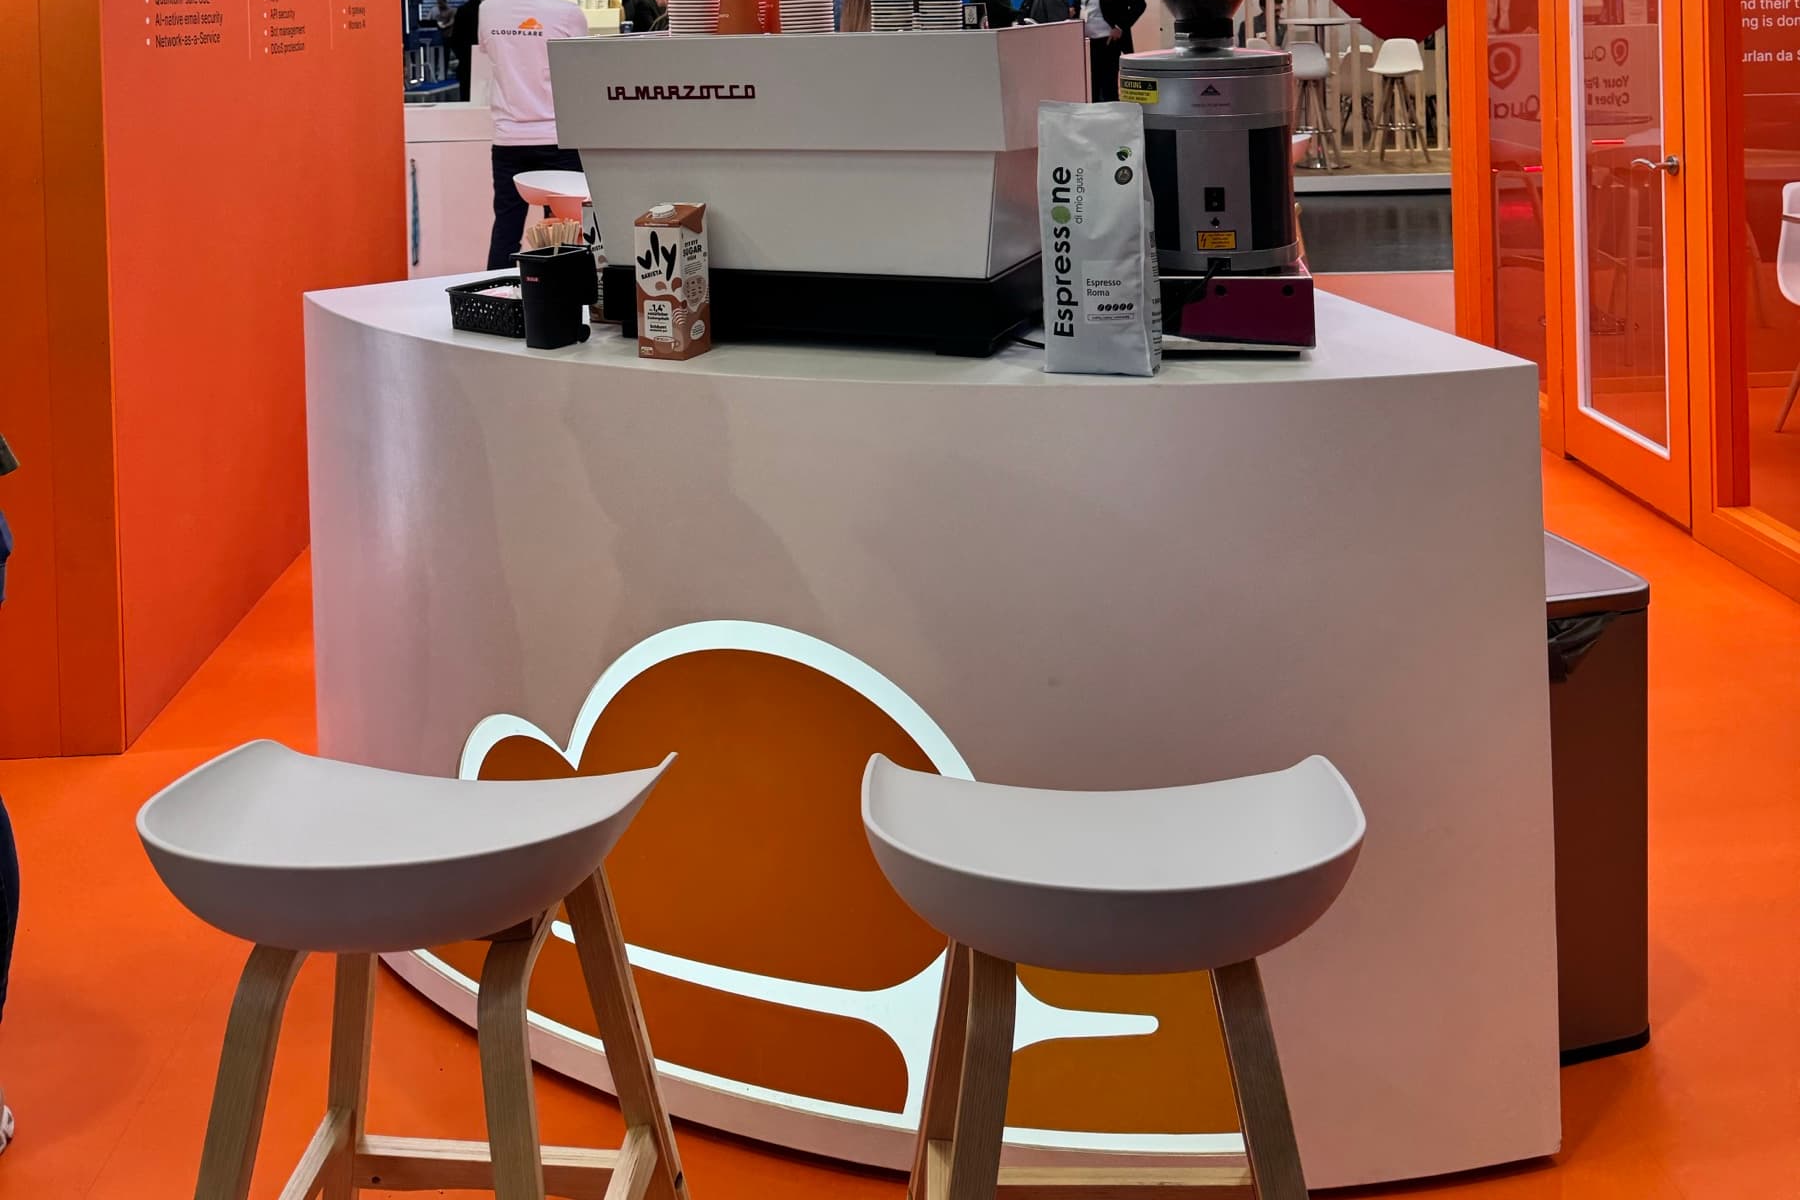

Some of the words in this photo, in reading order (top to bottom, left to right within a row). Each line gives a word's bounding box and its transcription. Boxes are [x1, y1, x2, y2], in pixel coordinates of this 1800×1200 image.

[201, 10, 223, 26] security
[1762, 14, 1773, 27] is
[155, 31, 221, 48] Network-as-a-Service
[490, 29, 543, 37] CLOUDFLARE
[1776, 49, 1793, 61] da
[1075, 167, 1085, 193] gusto
[1074, 195, 1084, 213] mio
[1074, 215, 1083, 225] di
[636, 230, 677, 282] vly
[1086, 278, 1122, 288] Espresso
[1086, 288, 1110, 297] Roma
